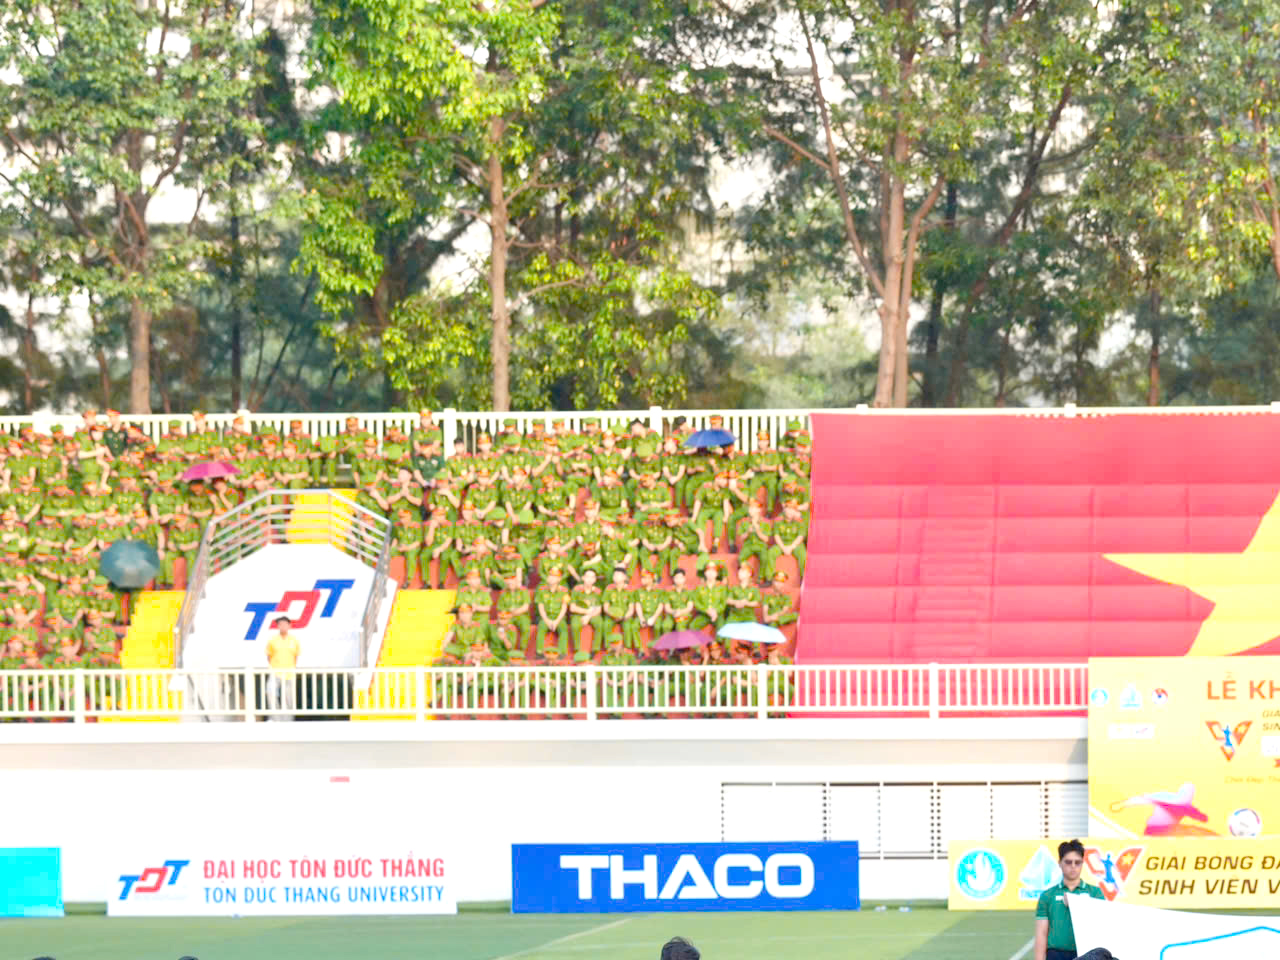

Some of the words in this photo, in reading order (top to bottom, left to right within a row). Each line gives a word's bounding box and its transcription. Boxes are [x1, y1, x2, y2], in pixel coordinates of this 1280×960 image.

[118, 859, 190, 900] TDT
[203, 859, 236, 884] ĐẠI
[243, 859, 282, 884] HỌC
[288, 855, 327, 879] TÔN
[333, 854, 373, 879] ĐỨC
[379, 850, 446, 878] THẮNG
[559, 852, 815, 900] THACO
[203, 886, 237, 904] TON
[244, 886, 278, 903] DUC
[283, 886, 341, 903] THANG
[348, 884, 445, 903] UNIVERSITY
[1138, 879, 1195, 895] SINH
[1205, 875, 1259, 895] VIÊN
